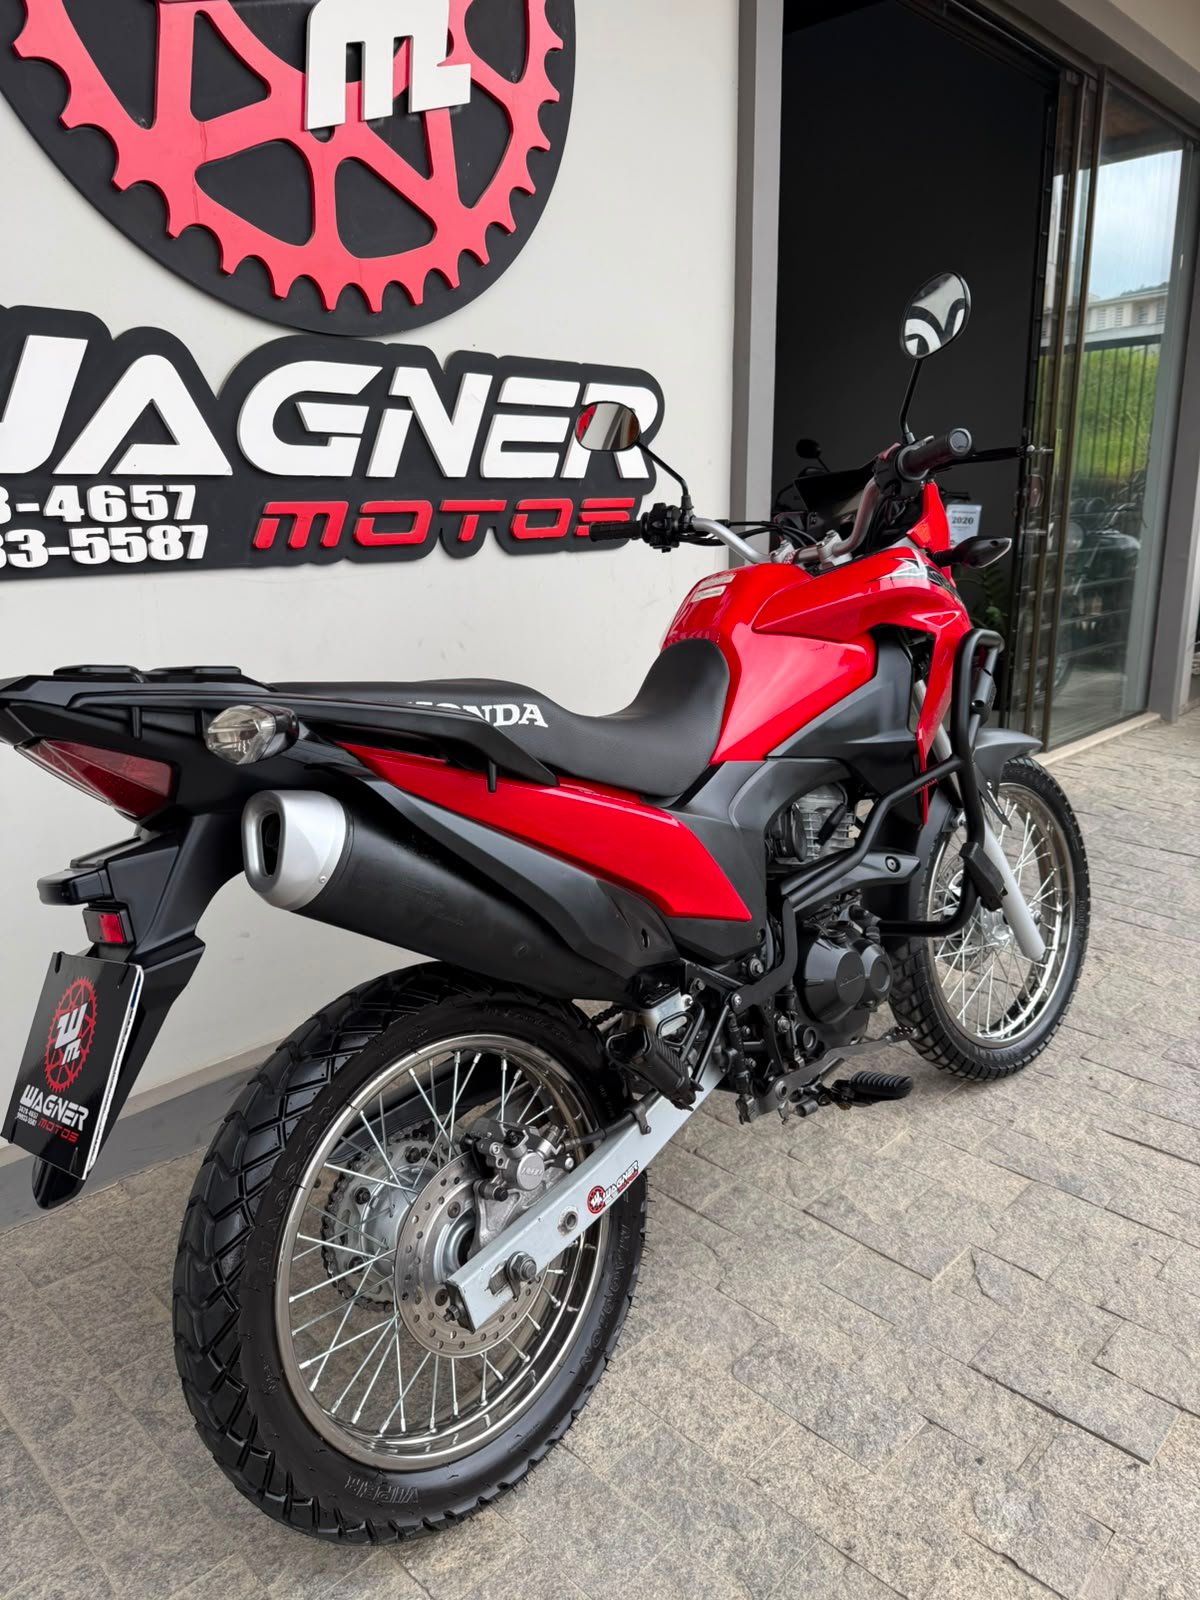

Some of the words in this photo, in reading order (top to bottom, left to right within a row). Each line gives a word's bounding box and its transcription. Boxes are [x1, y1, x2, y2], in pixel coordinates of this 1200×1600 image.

[0, 485, 196, 524] -4657
[252, 498, 635, 548] MOTOS
[951, 516, 974, 525] 2020
[0, 525, 208, 569] 3-5587
[407, 701, 549, 728] NDA
[20, 1085, 89, 1130] WAGNER
[37, 1117, 80, 1143] MOTOS
